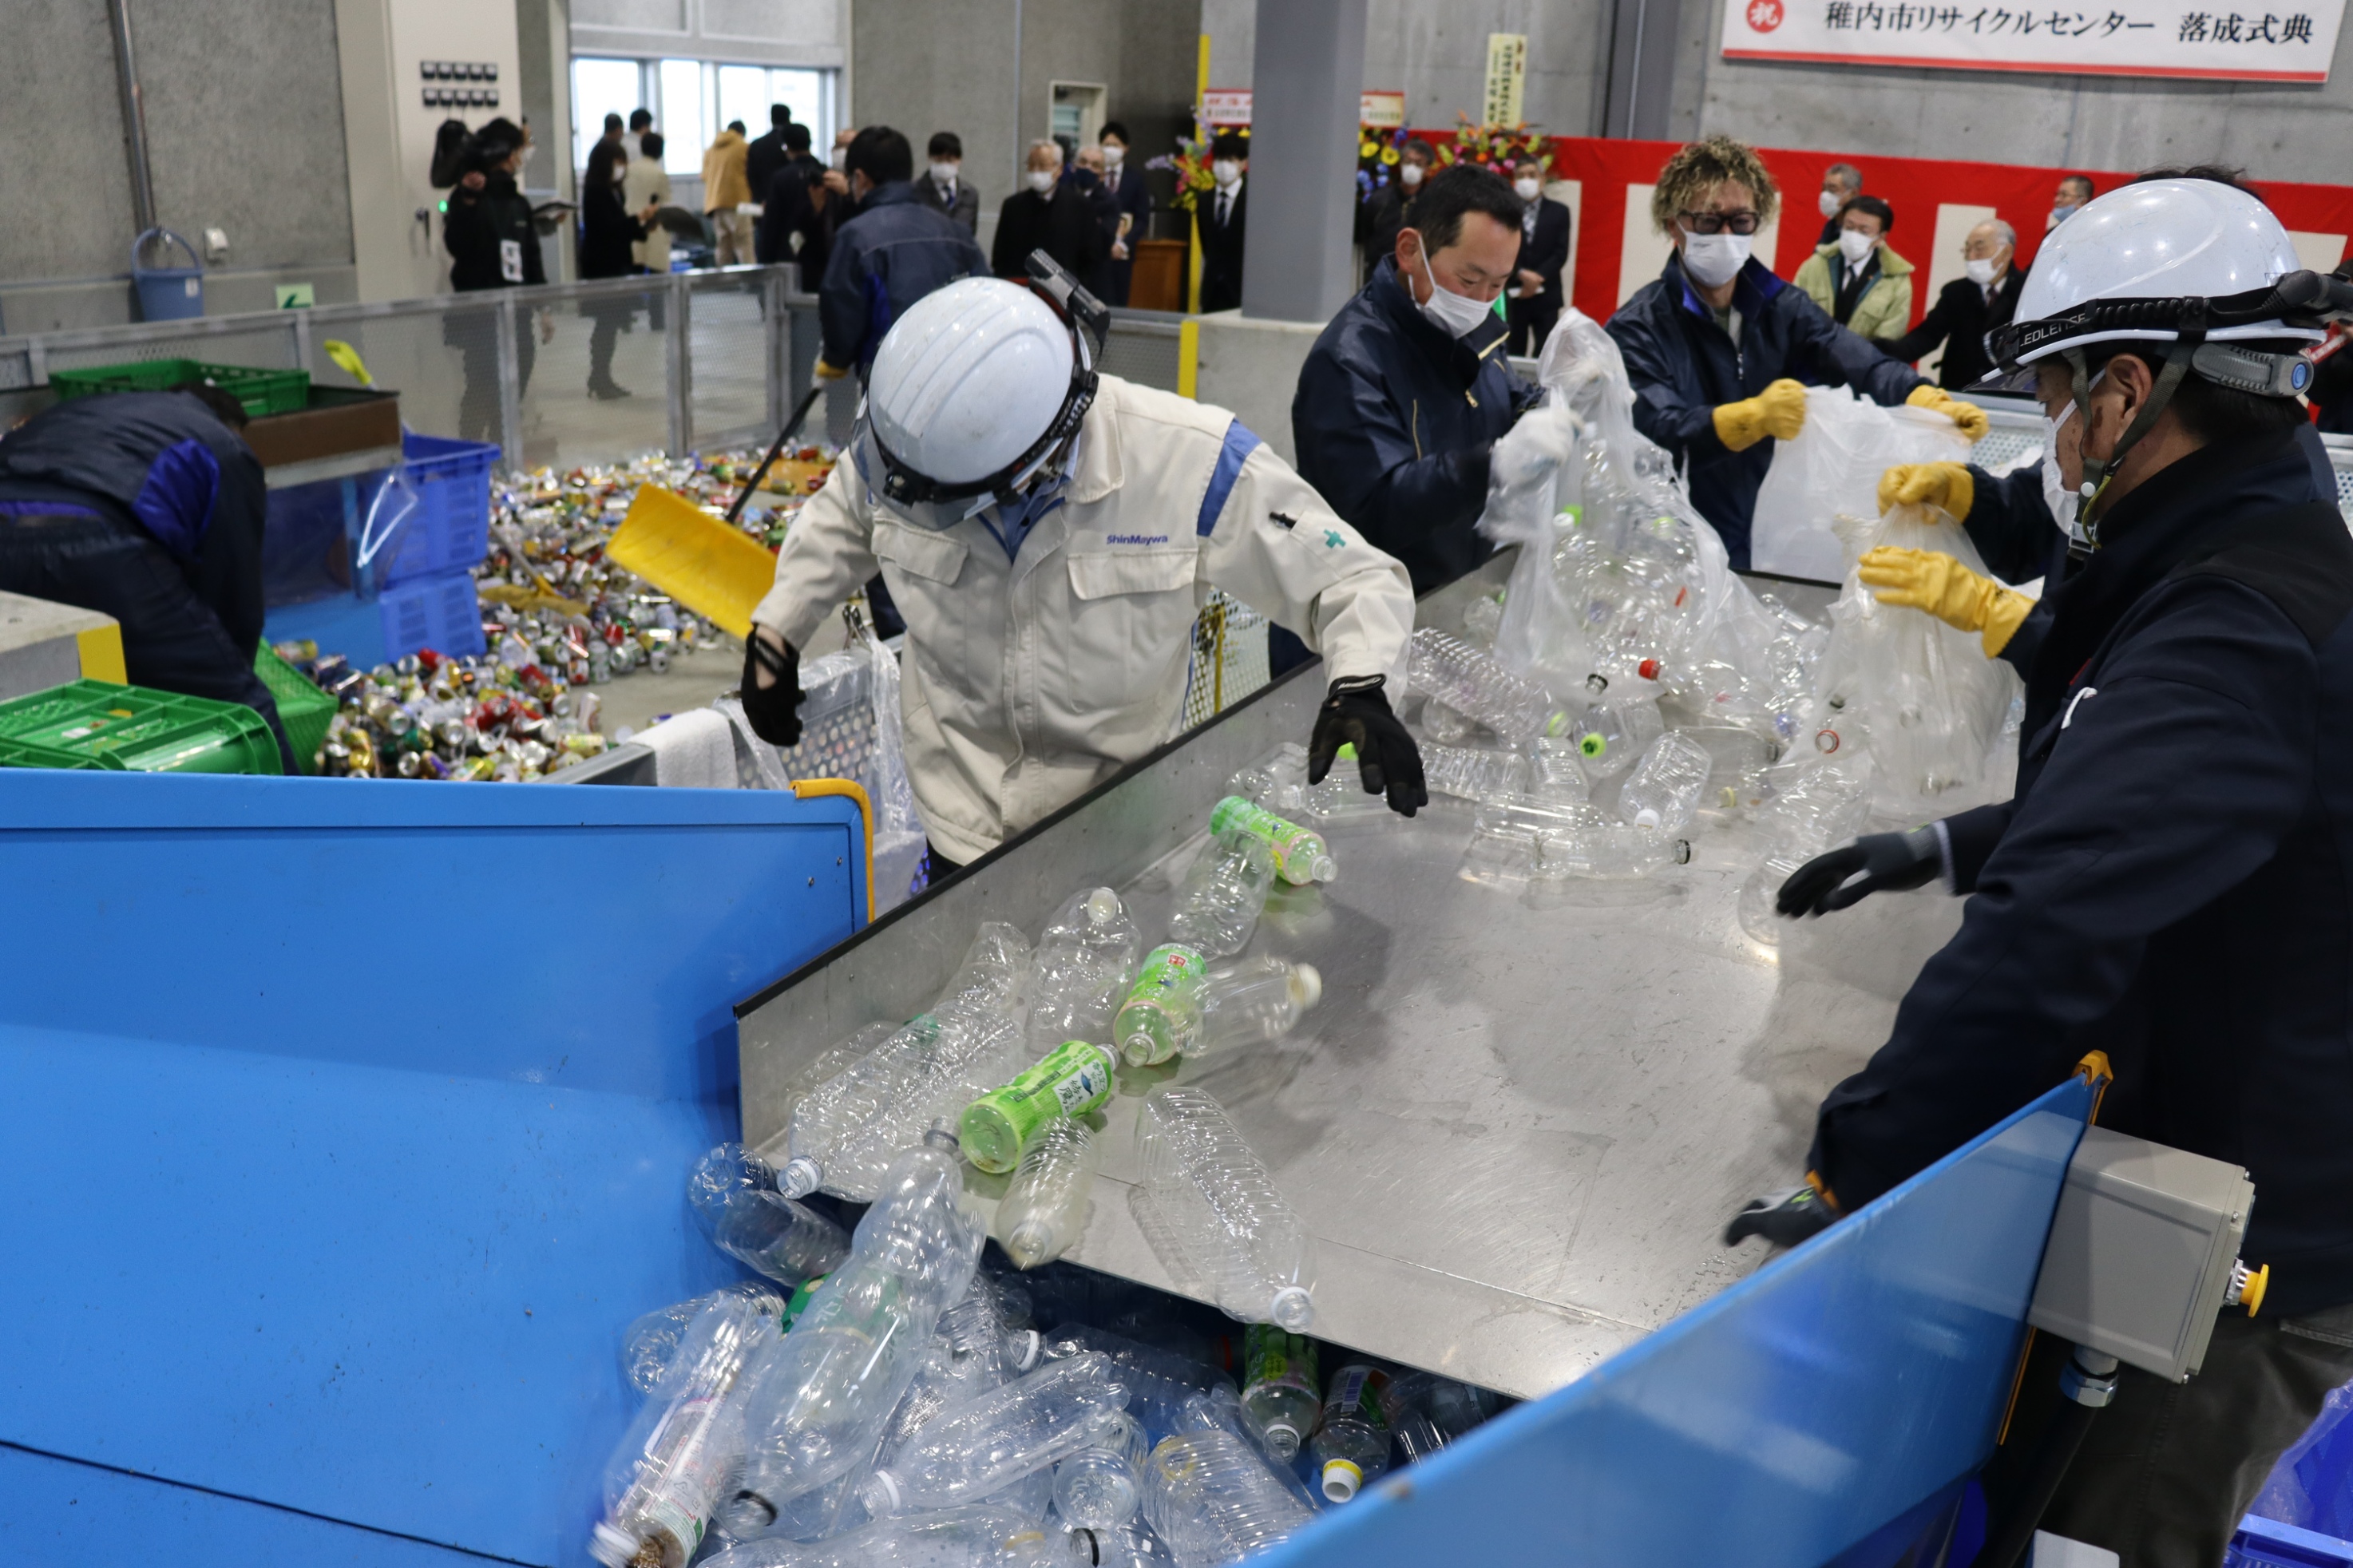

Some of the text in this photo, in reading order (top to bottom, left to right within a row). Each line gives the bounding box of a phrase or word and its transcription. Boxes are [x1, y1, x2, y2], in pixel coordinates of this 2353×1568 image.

[1750, 1, 2313, 43] 祝 稚内市リサイクルセンター 落成式典
[1107, 534, 1168, 546] ShinMaywa
